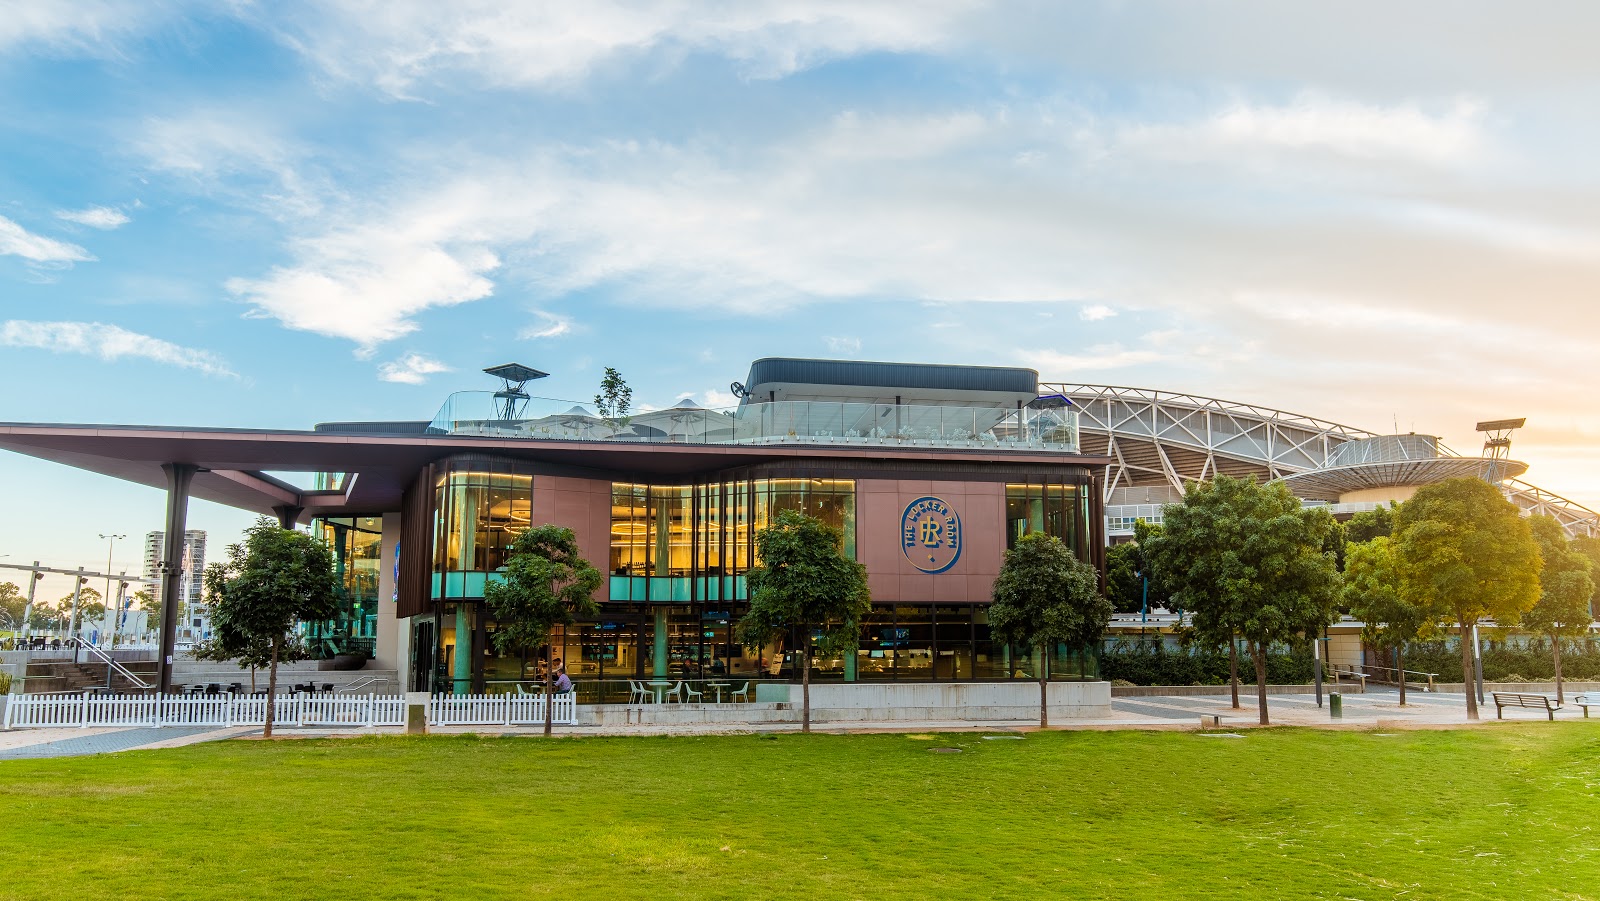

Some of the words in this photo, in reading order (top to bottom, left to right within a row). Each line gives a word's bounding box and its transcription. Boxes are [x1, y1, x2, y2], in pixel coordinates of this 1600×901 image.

[907, 501, 948, 522] LOCKER
[905, 525, 914, 546] THE
[945, 516, 955, 547] ROOM
